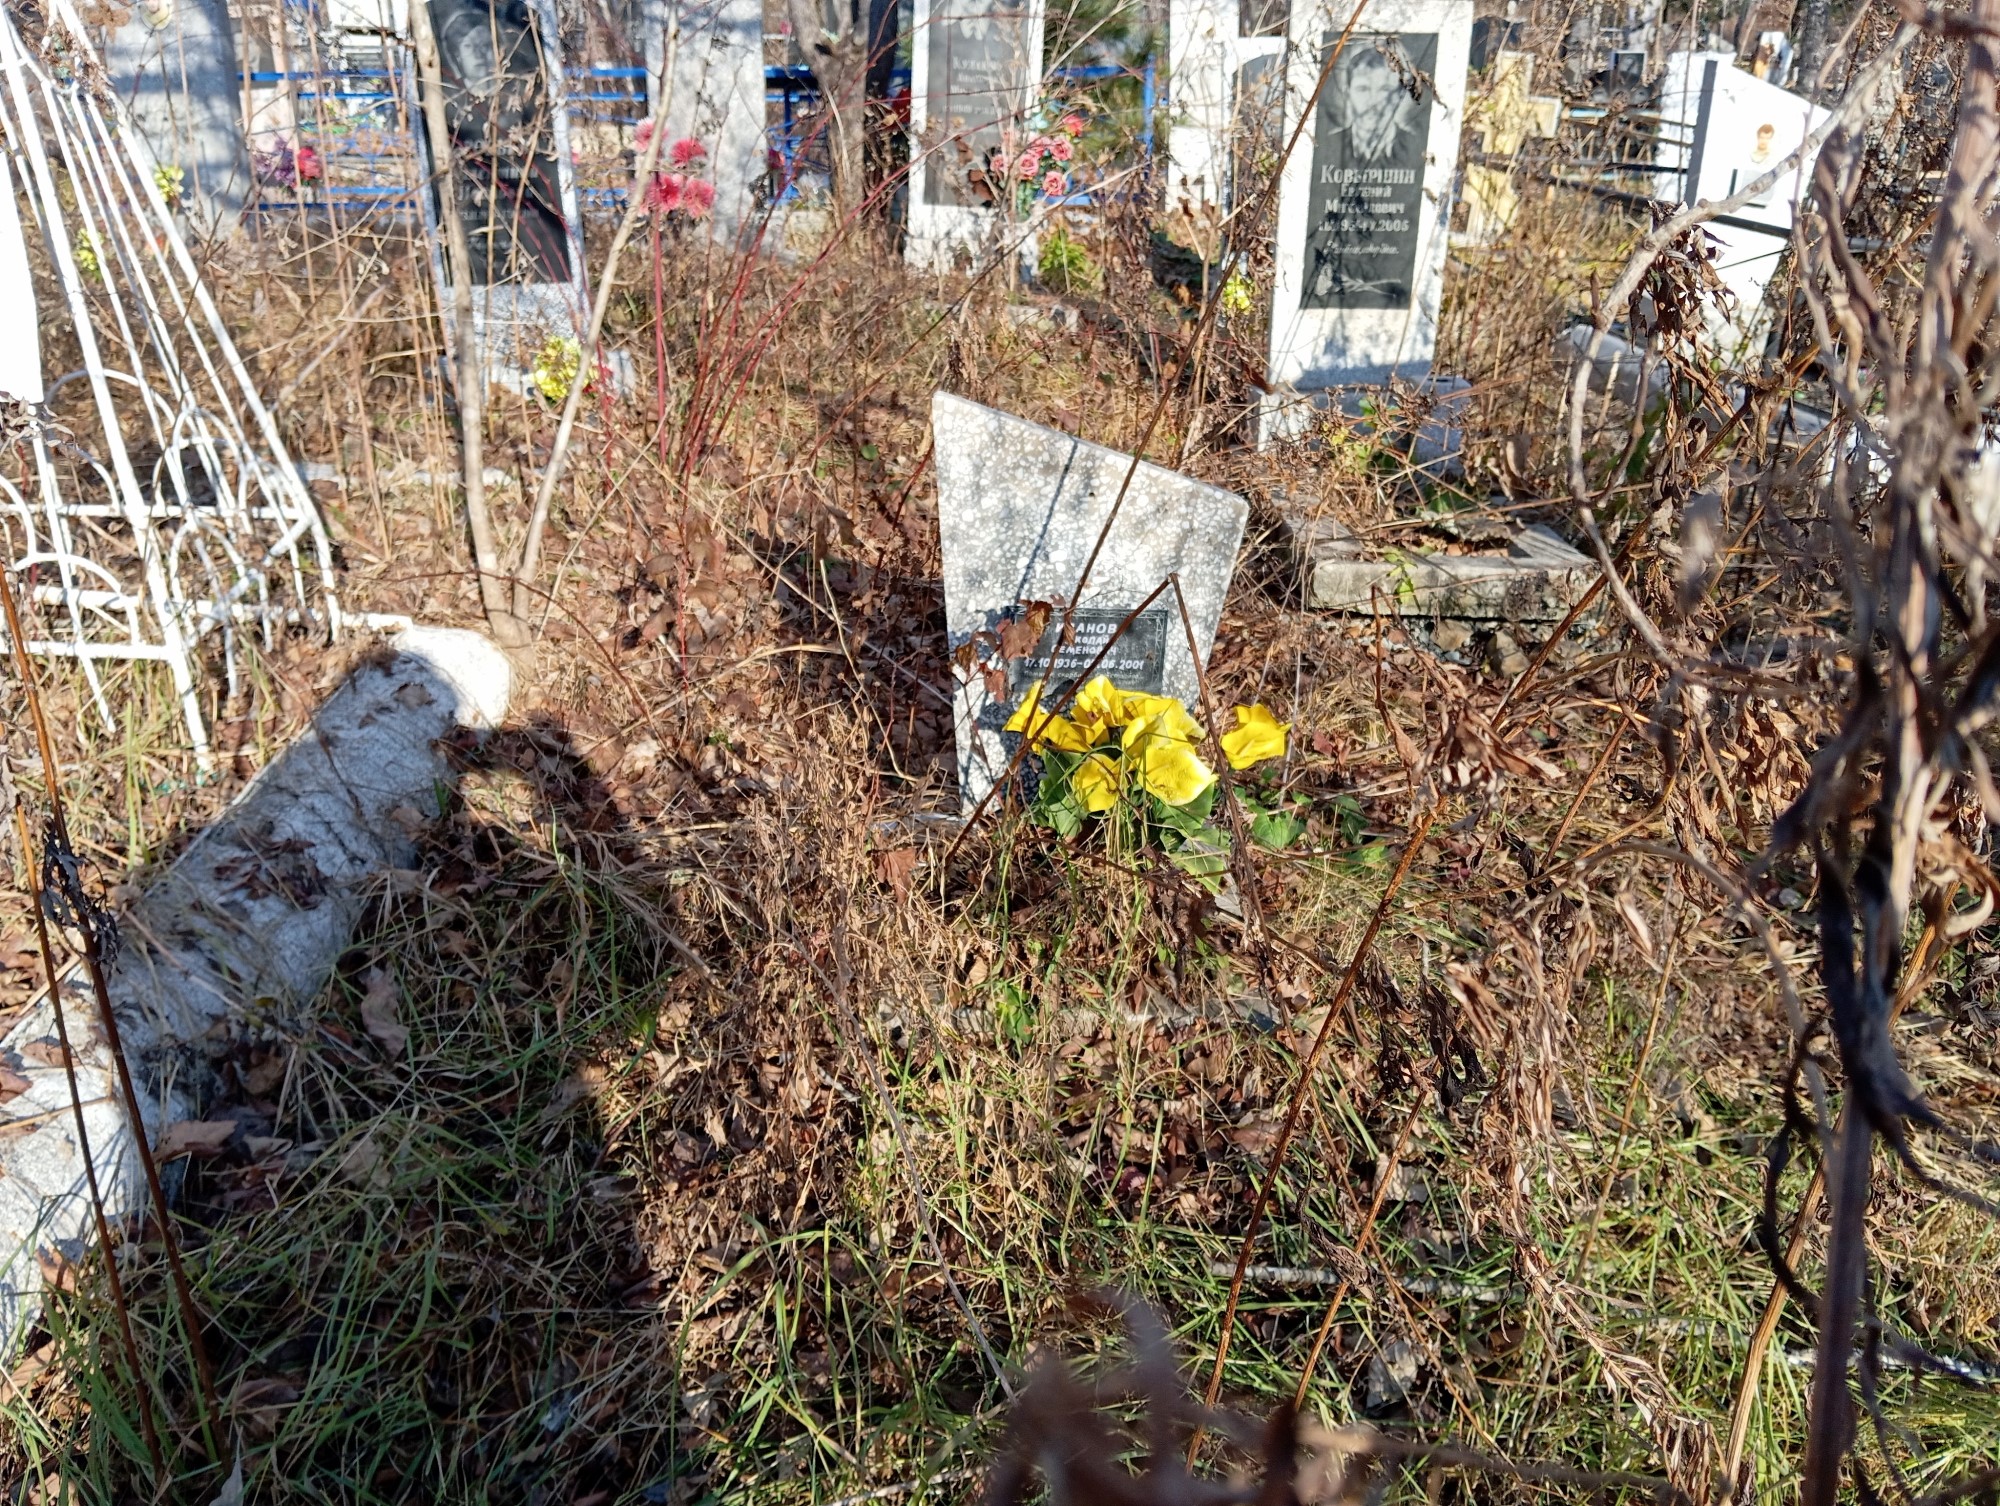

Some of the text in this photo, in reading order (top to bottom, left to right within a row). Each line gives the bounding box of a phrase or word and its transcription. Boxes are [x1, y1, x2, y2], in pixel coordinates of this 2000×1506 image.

[1055, 622, 1118, 634] ИАНОВ
[1060, 634, 1111, 646] КОЛАЙ
[1050, 644, 1117, 656] СЕМЕНОВЧ
